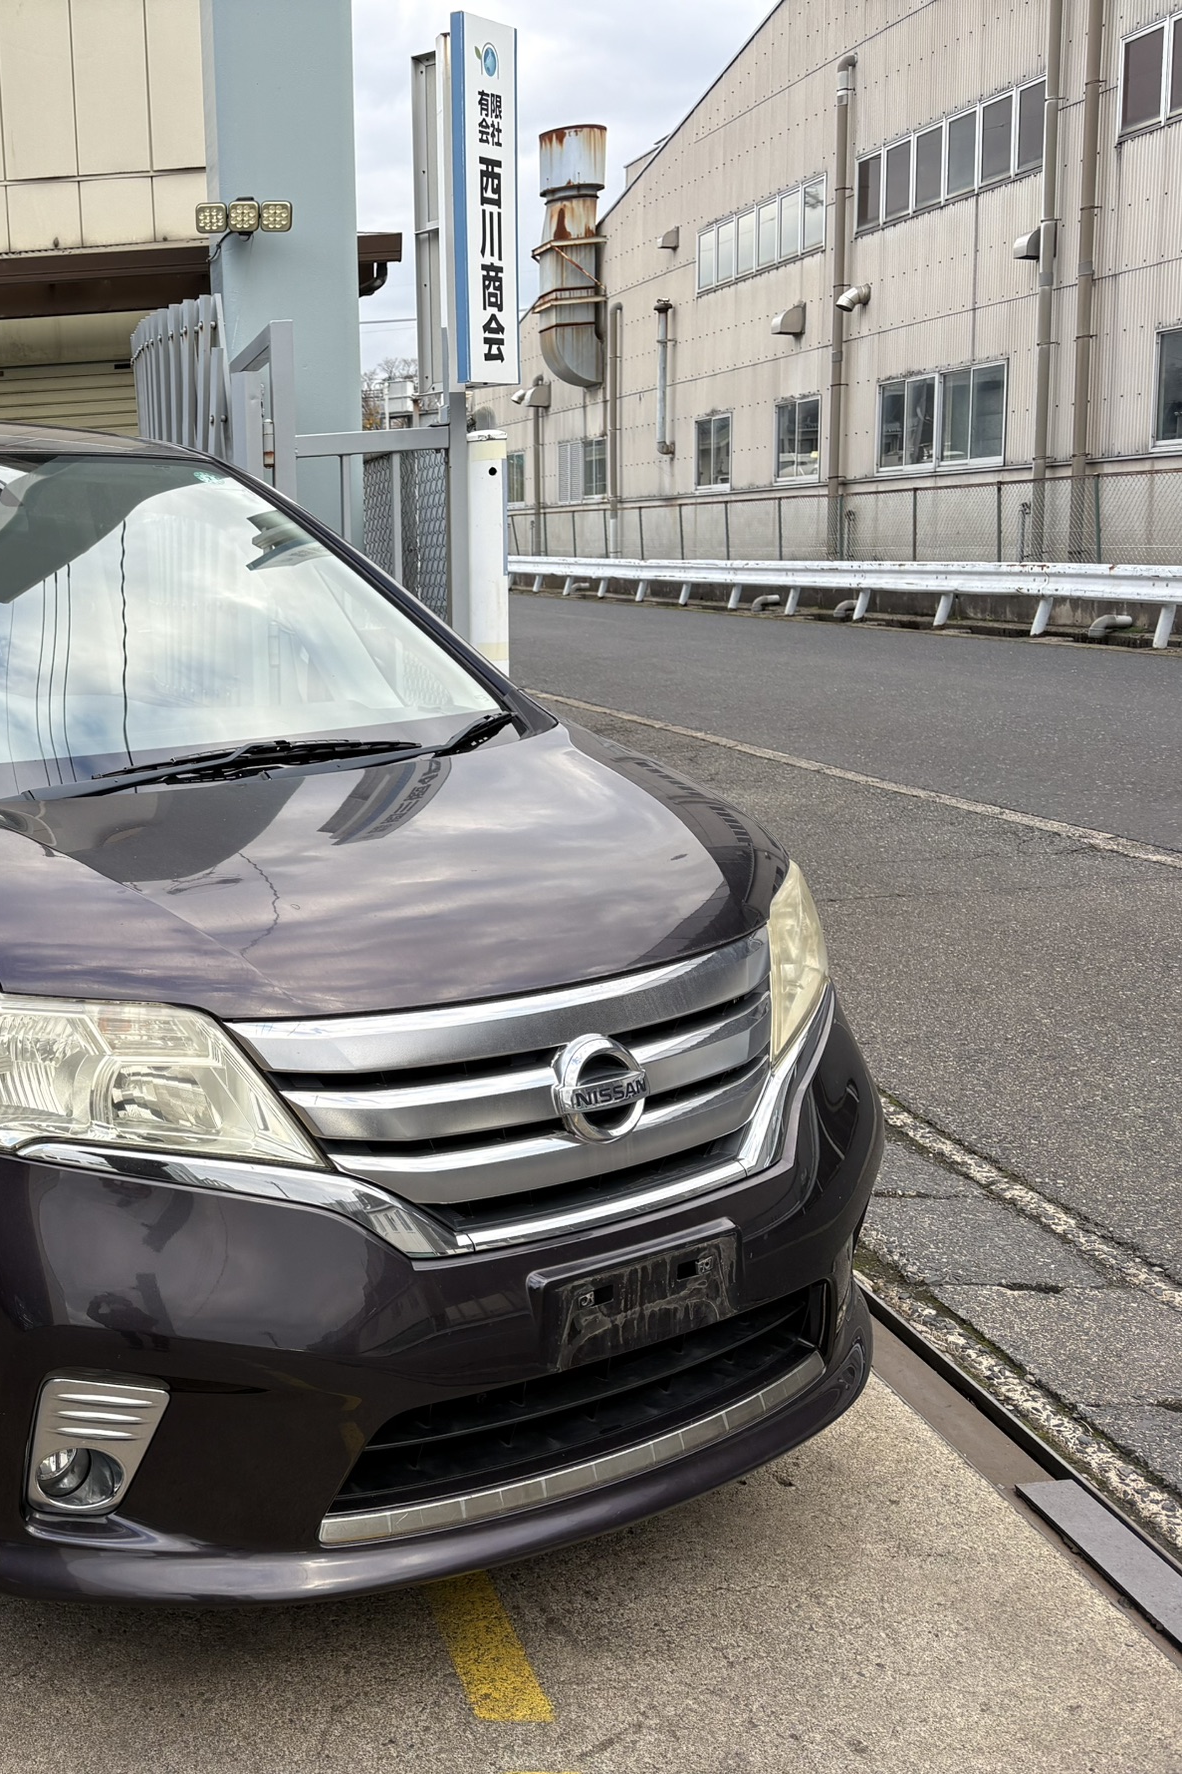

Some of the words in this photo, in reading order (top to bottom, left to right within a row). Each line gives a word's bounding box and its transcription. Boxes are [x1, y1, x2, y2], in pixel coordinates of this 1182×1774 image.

[479, 156, 505, 364] 西川商会
[574, 1079, 647, 1107] NISSAN
